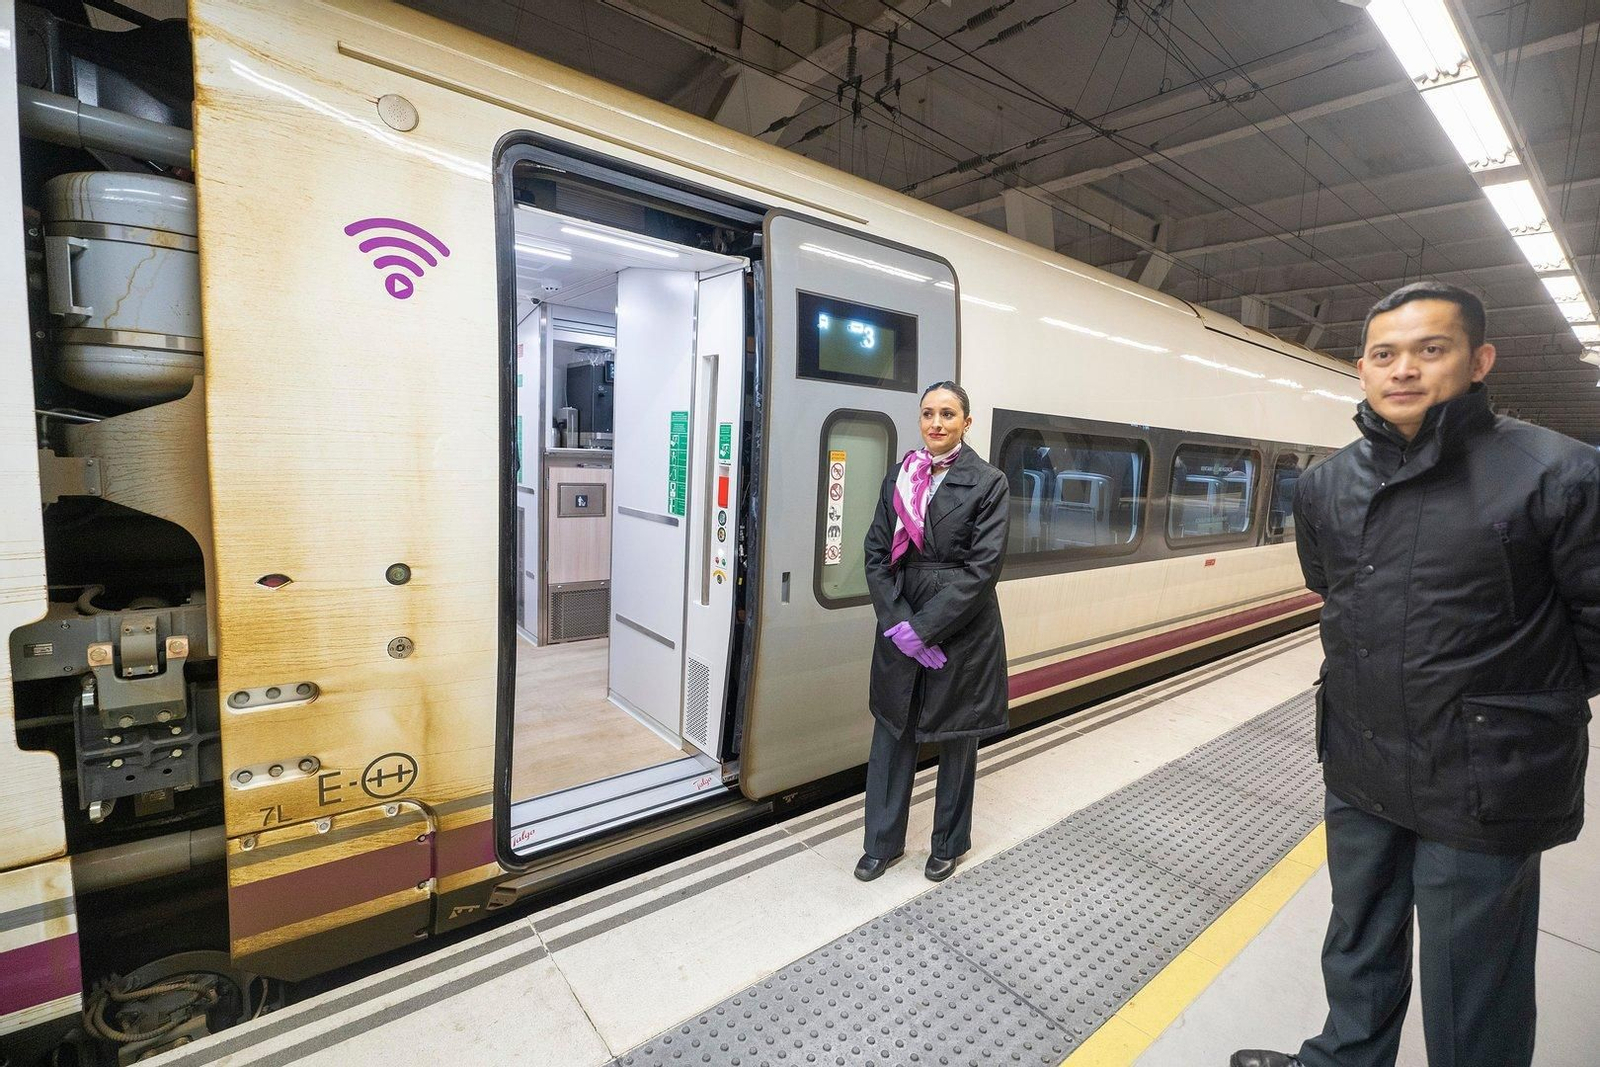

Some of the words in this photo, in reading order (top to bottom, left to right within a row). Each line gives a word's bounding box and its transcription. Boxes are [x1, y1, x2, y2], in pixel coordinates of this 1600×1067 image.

[860, 326, 875, 349] 3
[259, 804, 293, 826] 7L
[511, 829, 536, 847] Talgo
